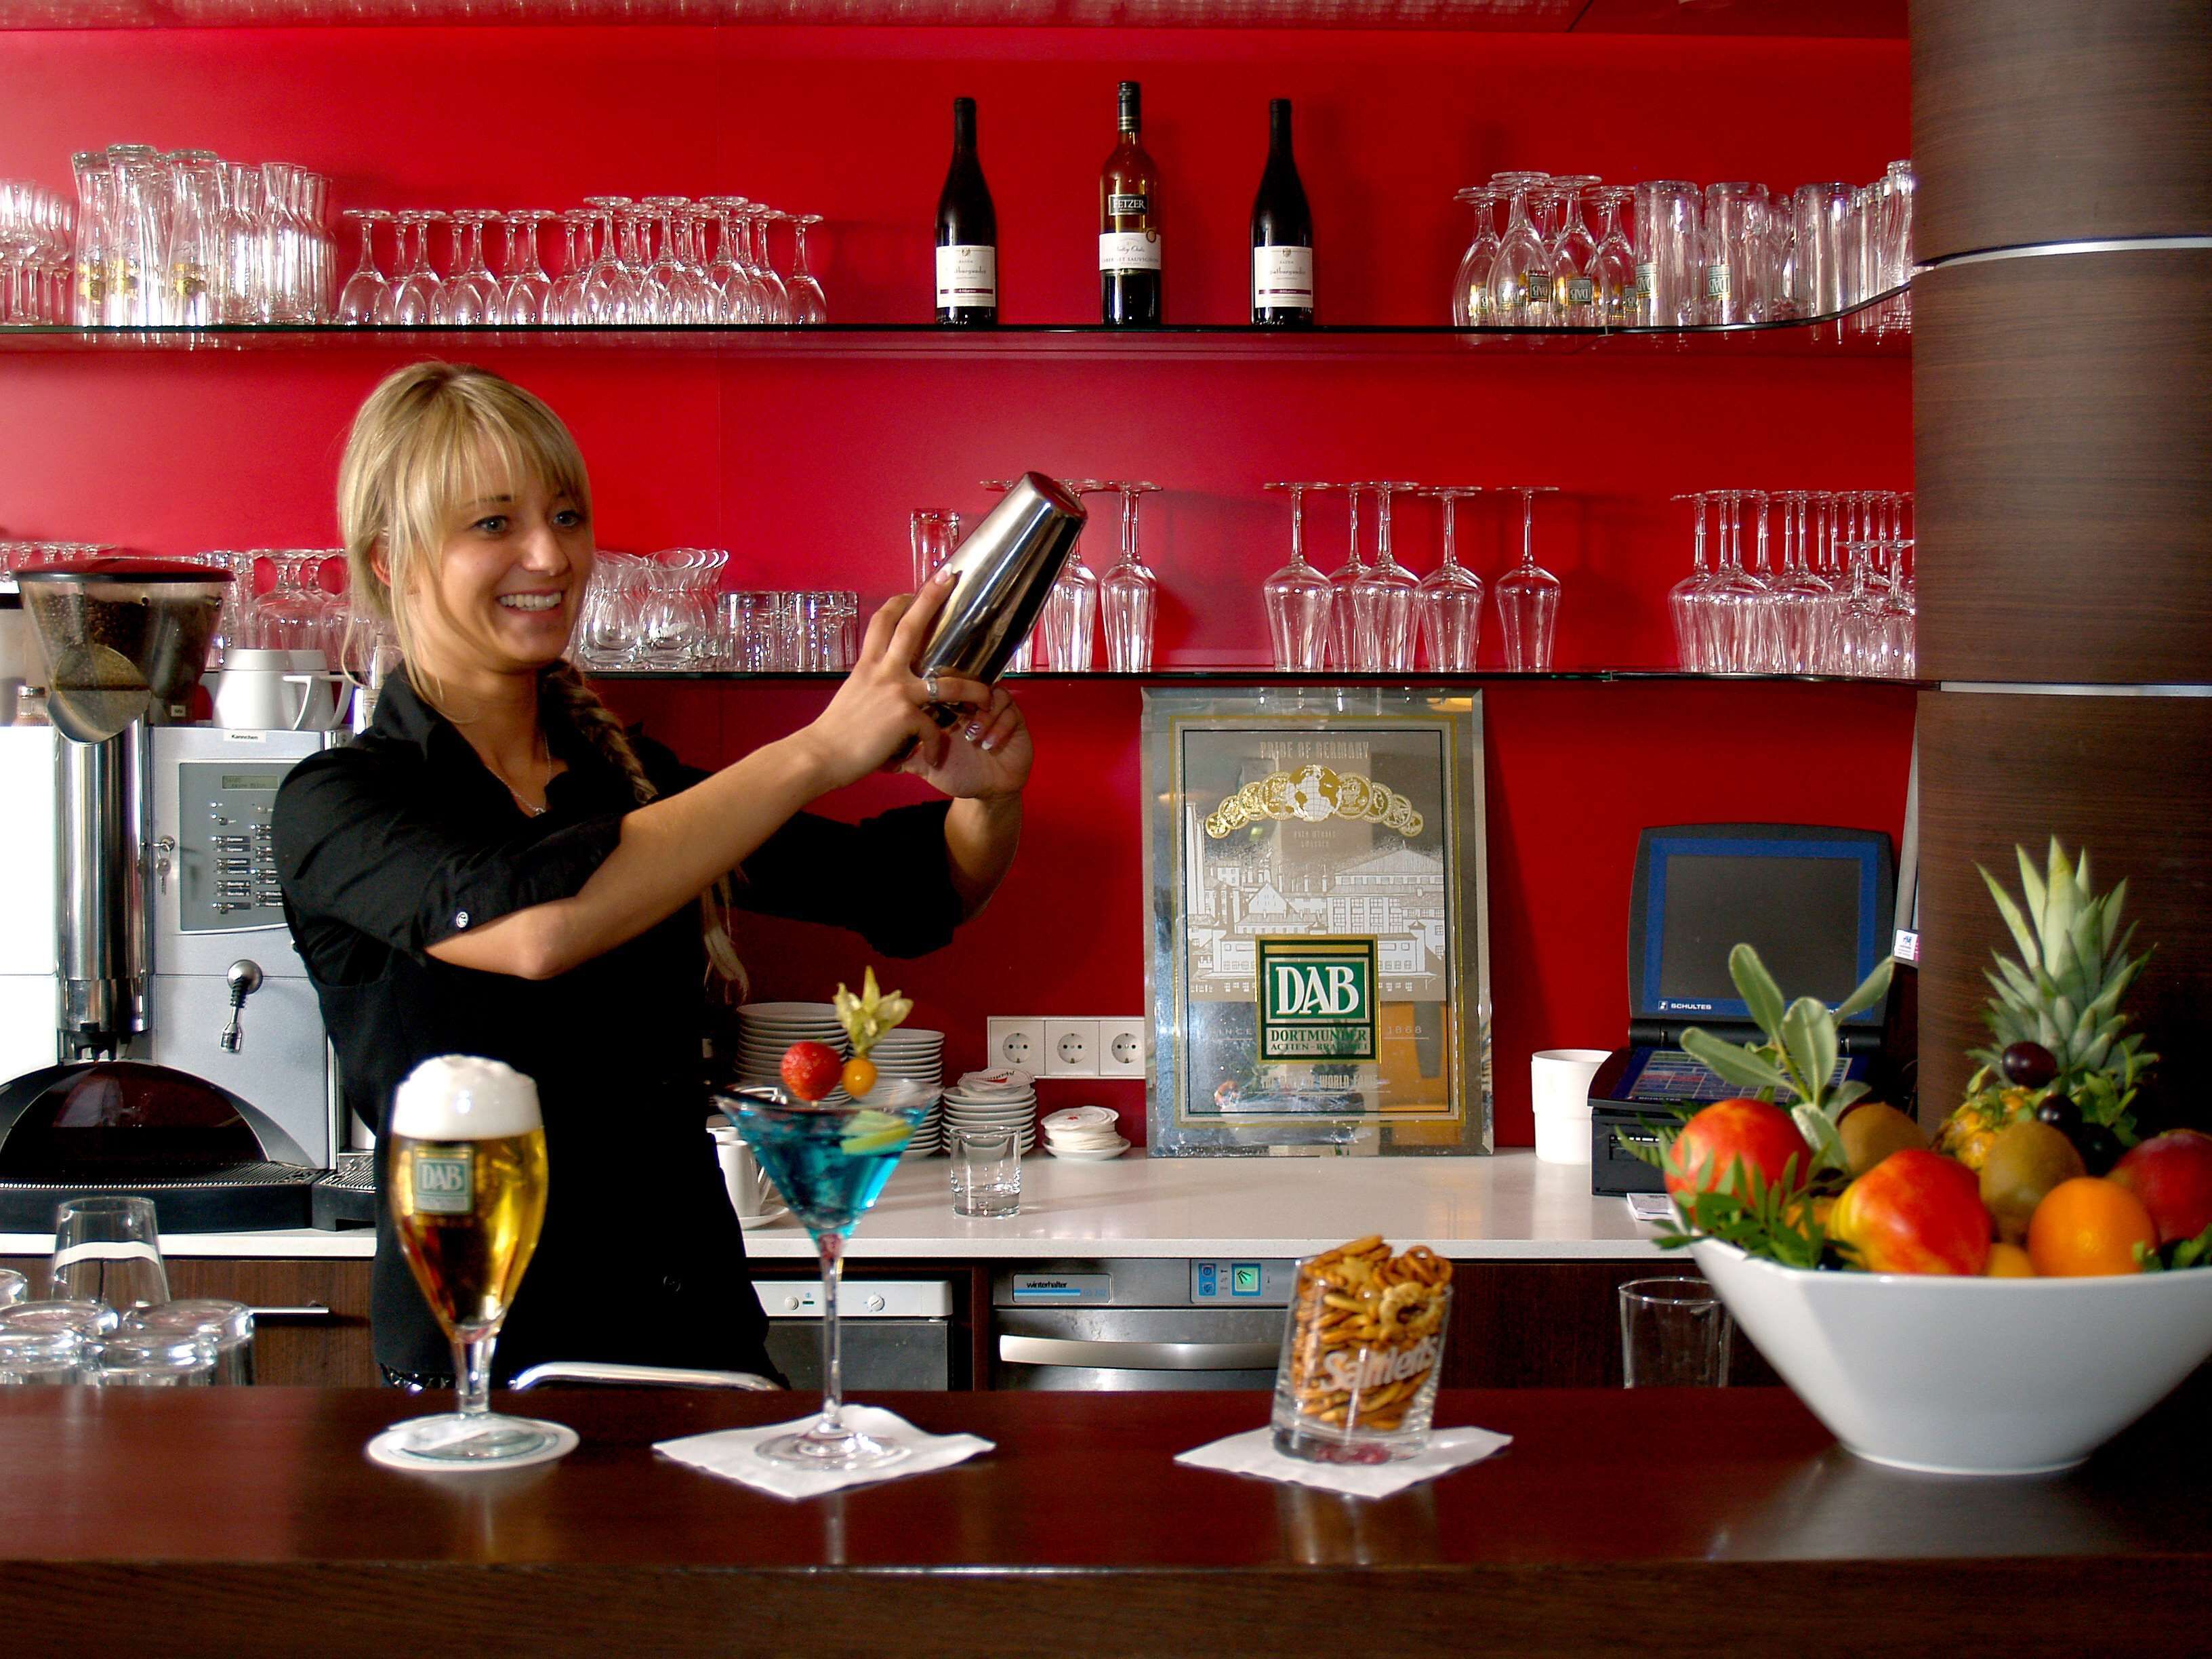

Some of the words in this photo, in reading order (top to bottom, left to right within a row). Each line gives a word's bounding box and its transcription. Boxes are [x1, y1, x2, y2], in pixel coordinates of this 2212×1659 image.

[1113, 199, 1146, 209] FETZER
[1532, 285, 1549, 298] DAB
[1570, 287, 1590, 300] DAB
[1298, 741, 1311, 759] OF
[1275, 966, 1360, 1015] DAB
[1670, 1002, 1712, 1010] SCHULTES
[1387, 1025, 1423, 1034] 1868
[1319, 1074, 1350, 1089] WORLD
[422, 1164, 463, 1191] DAB
[1025, 1280, 1068, 1289] winterhalter
